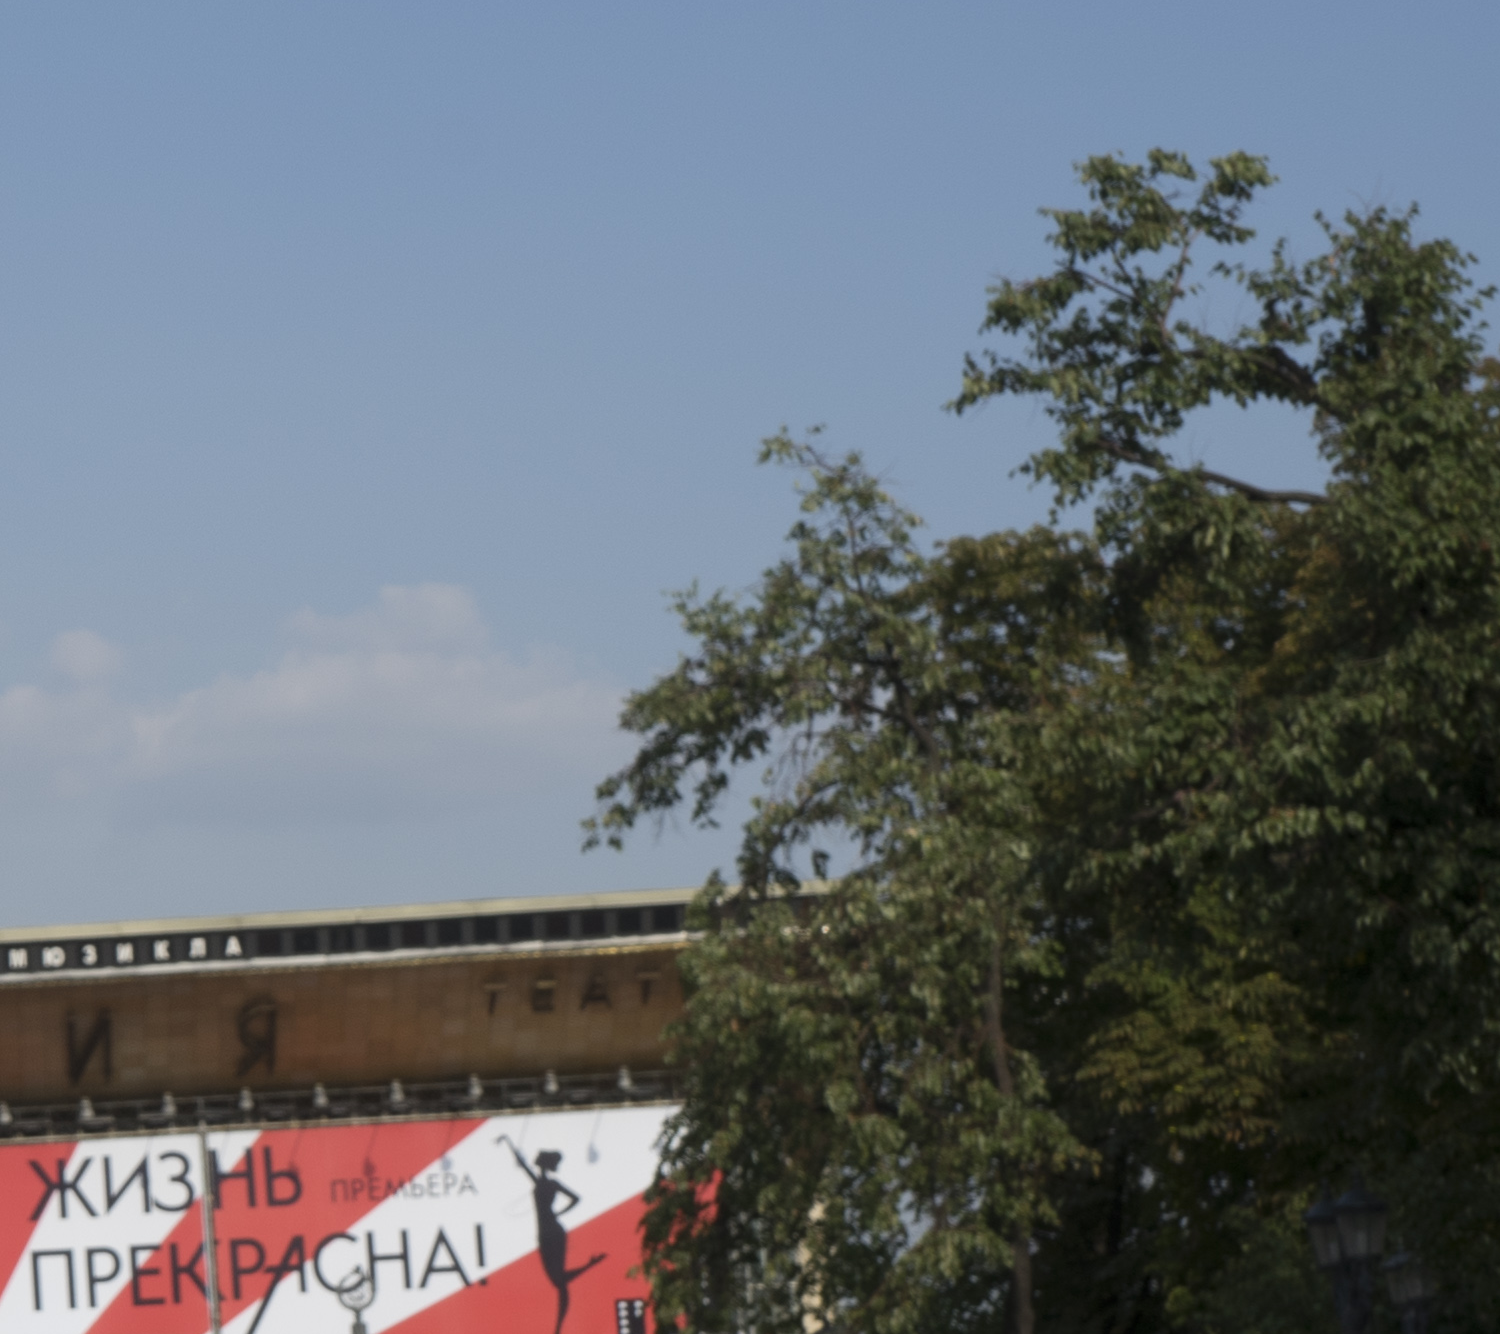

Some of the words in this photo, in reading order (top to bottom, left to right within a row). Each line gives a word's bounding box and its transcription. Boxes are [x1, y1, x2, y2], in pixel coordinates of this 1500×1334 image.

[8, 935, 243, 969] МЮЗИКЛА
[484, 970, 662, 1015] ТЕАТ
[26, 1145, 303, 1222] ЖИЗНЬ
[330, 1173, 479, 1203] ПРЕМЬЕРА
